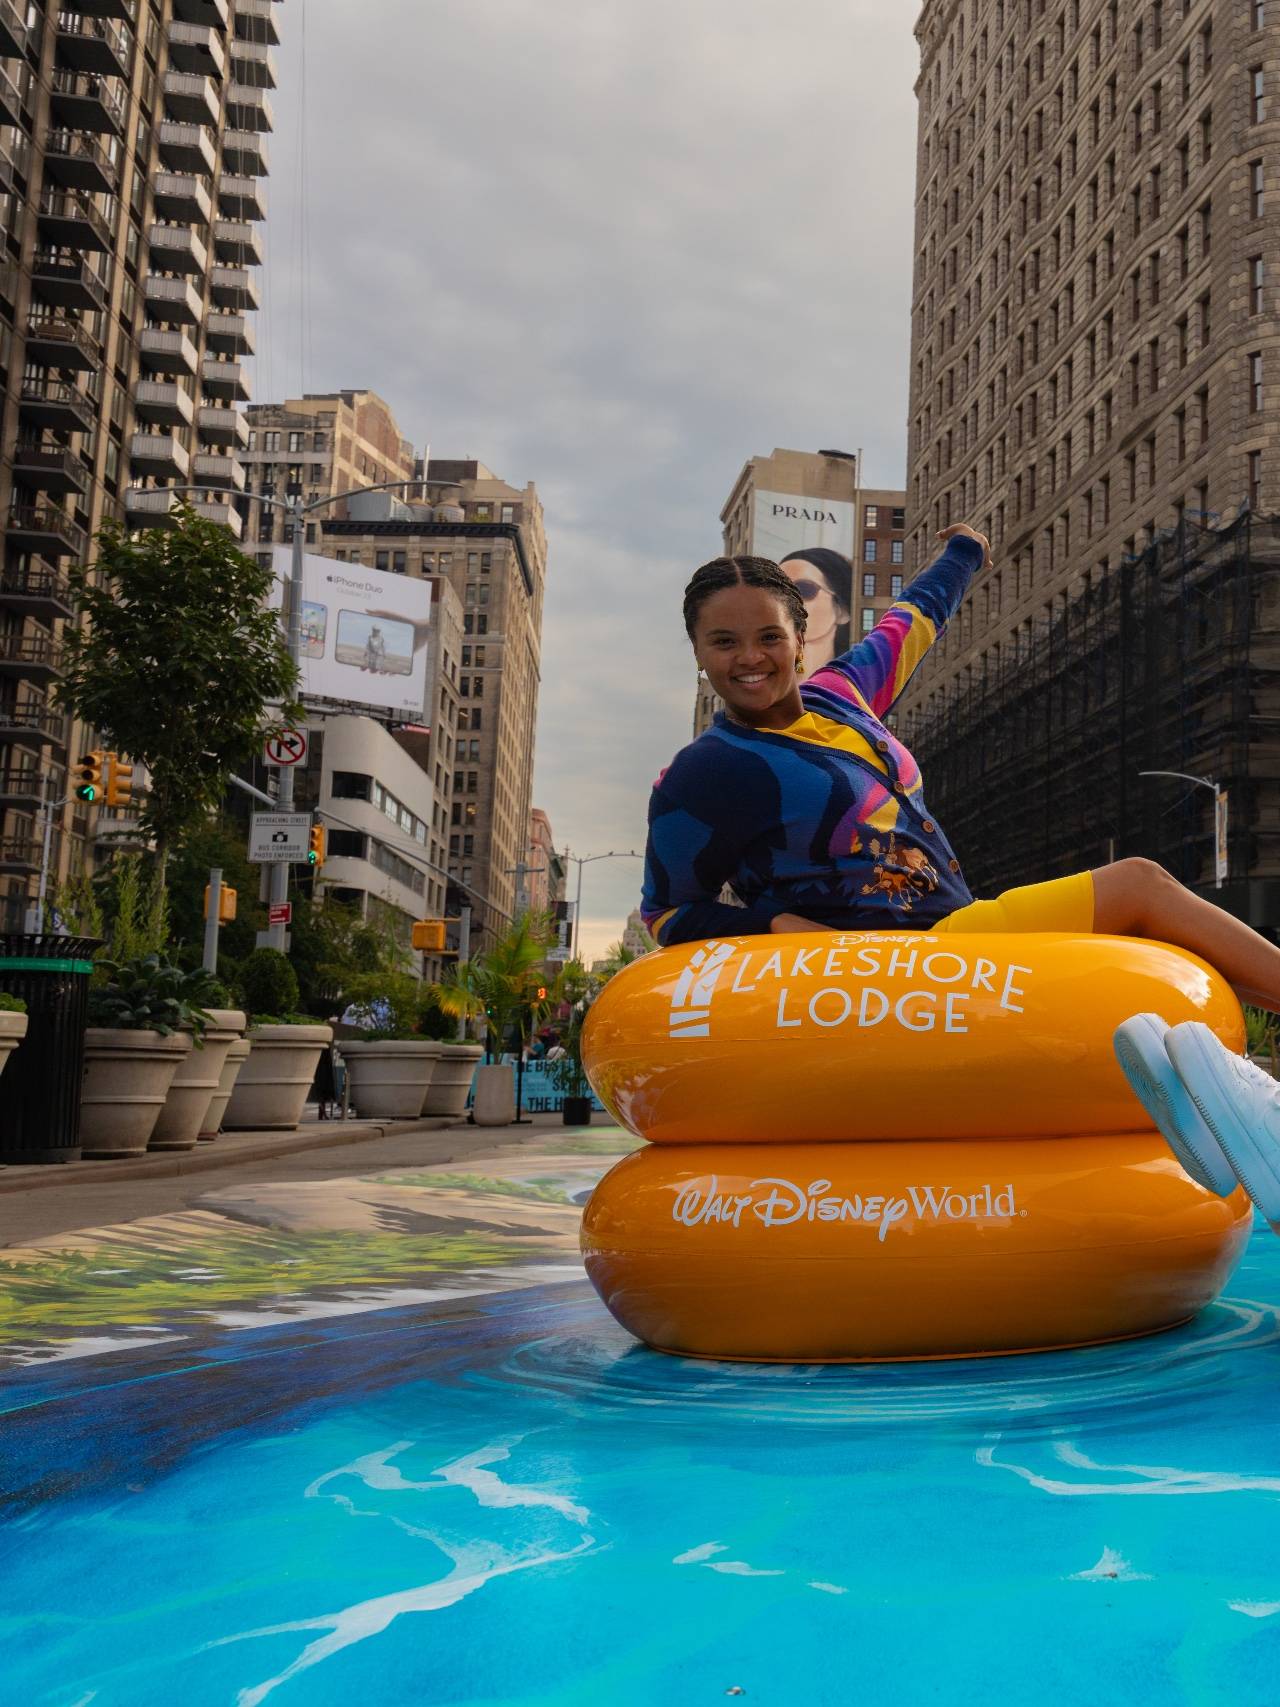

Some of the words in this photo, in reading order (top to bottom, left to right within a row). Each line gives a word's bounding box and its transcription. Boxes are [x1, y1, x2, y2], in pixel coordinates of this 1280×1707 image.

[772, 504, 837, 524] PRADA
[333, 576, 364, 591] iPhone
[365, 582, 384, 594] Duo
[731, 947, 1033, 1013] LAKESHORE
[776, 987, 970, 1033] LODGE
[528, 1097, 551, 1111] THE
